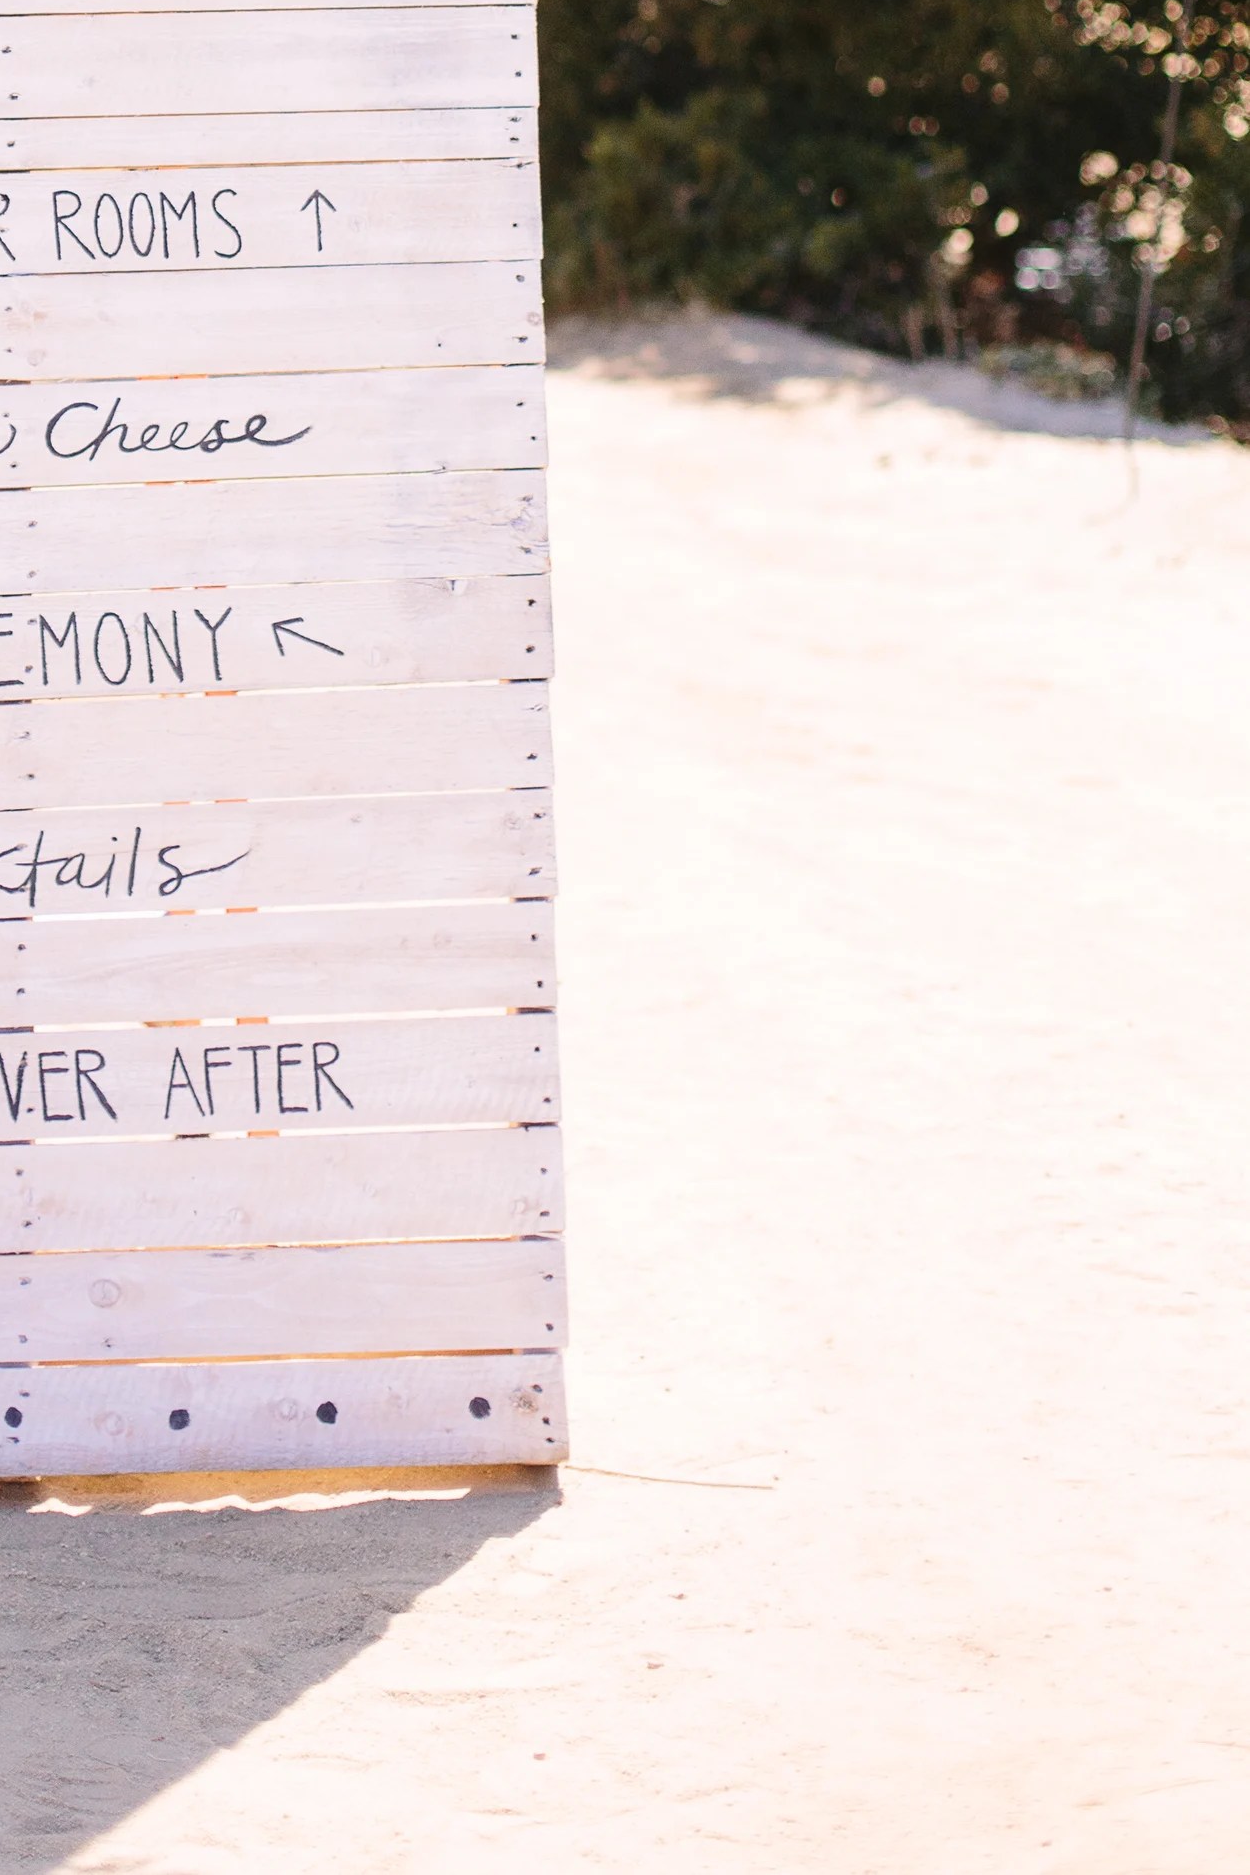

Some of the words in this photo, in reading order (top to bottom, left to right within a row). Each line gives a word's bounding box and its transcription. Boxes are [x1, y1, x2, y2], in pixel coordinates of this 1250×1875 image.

[52, 188, 243, 261] ROOMS
[45, 397, 312, 461] Cheese
[164, 1041, 355, 1119] AFTER
